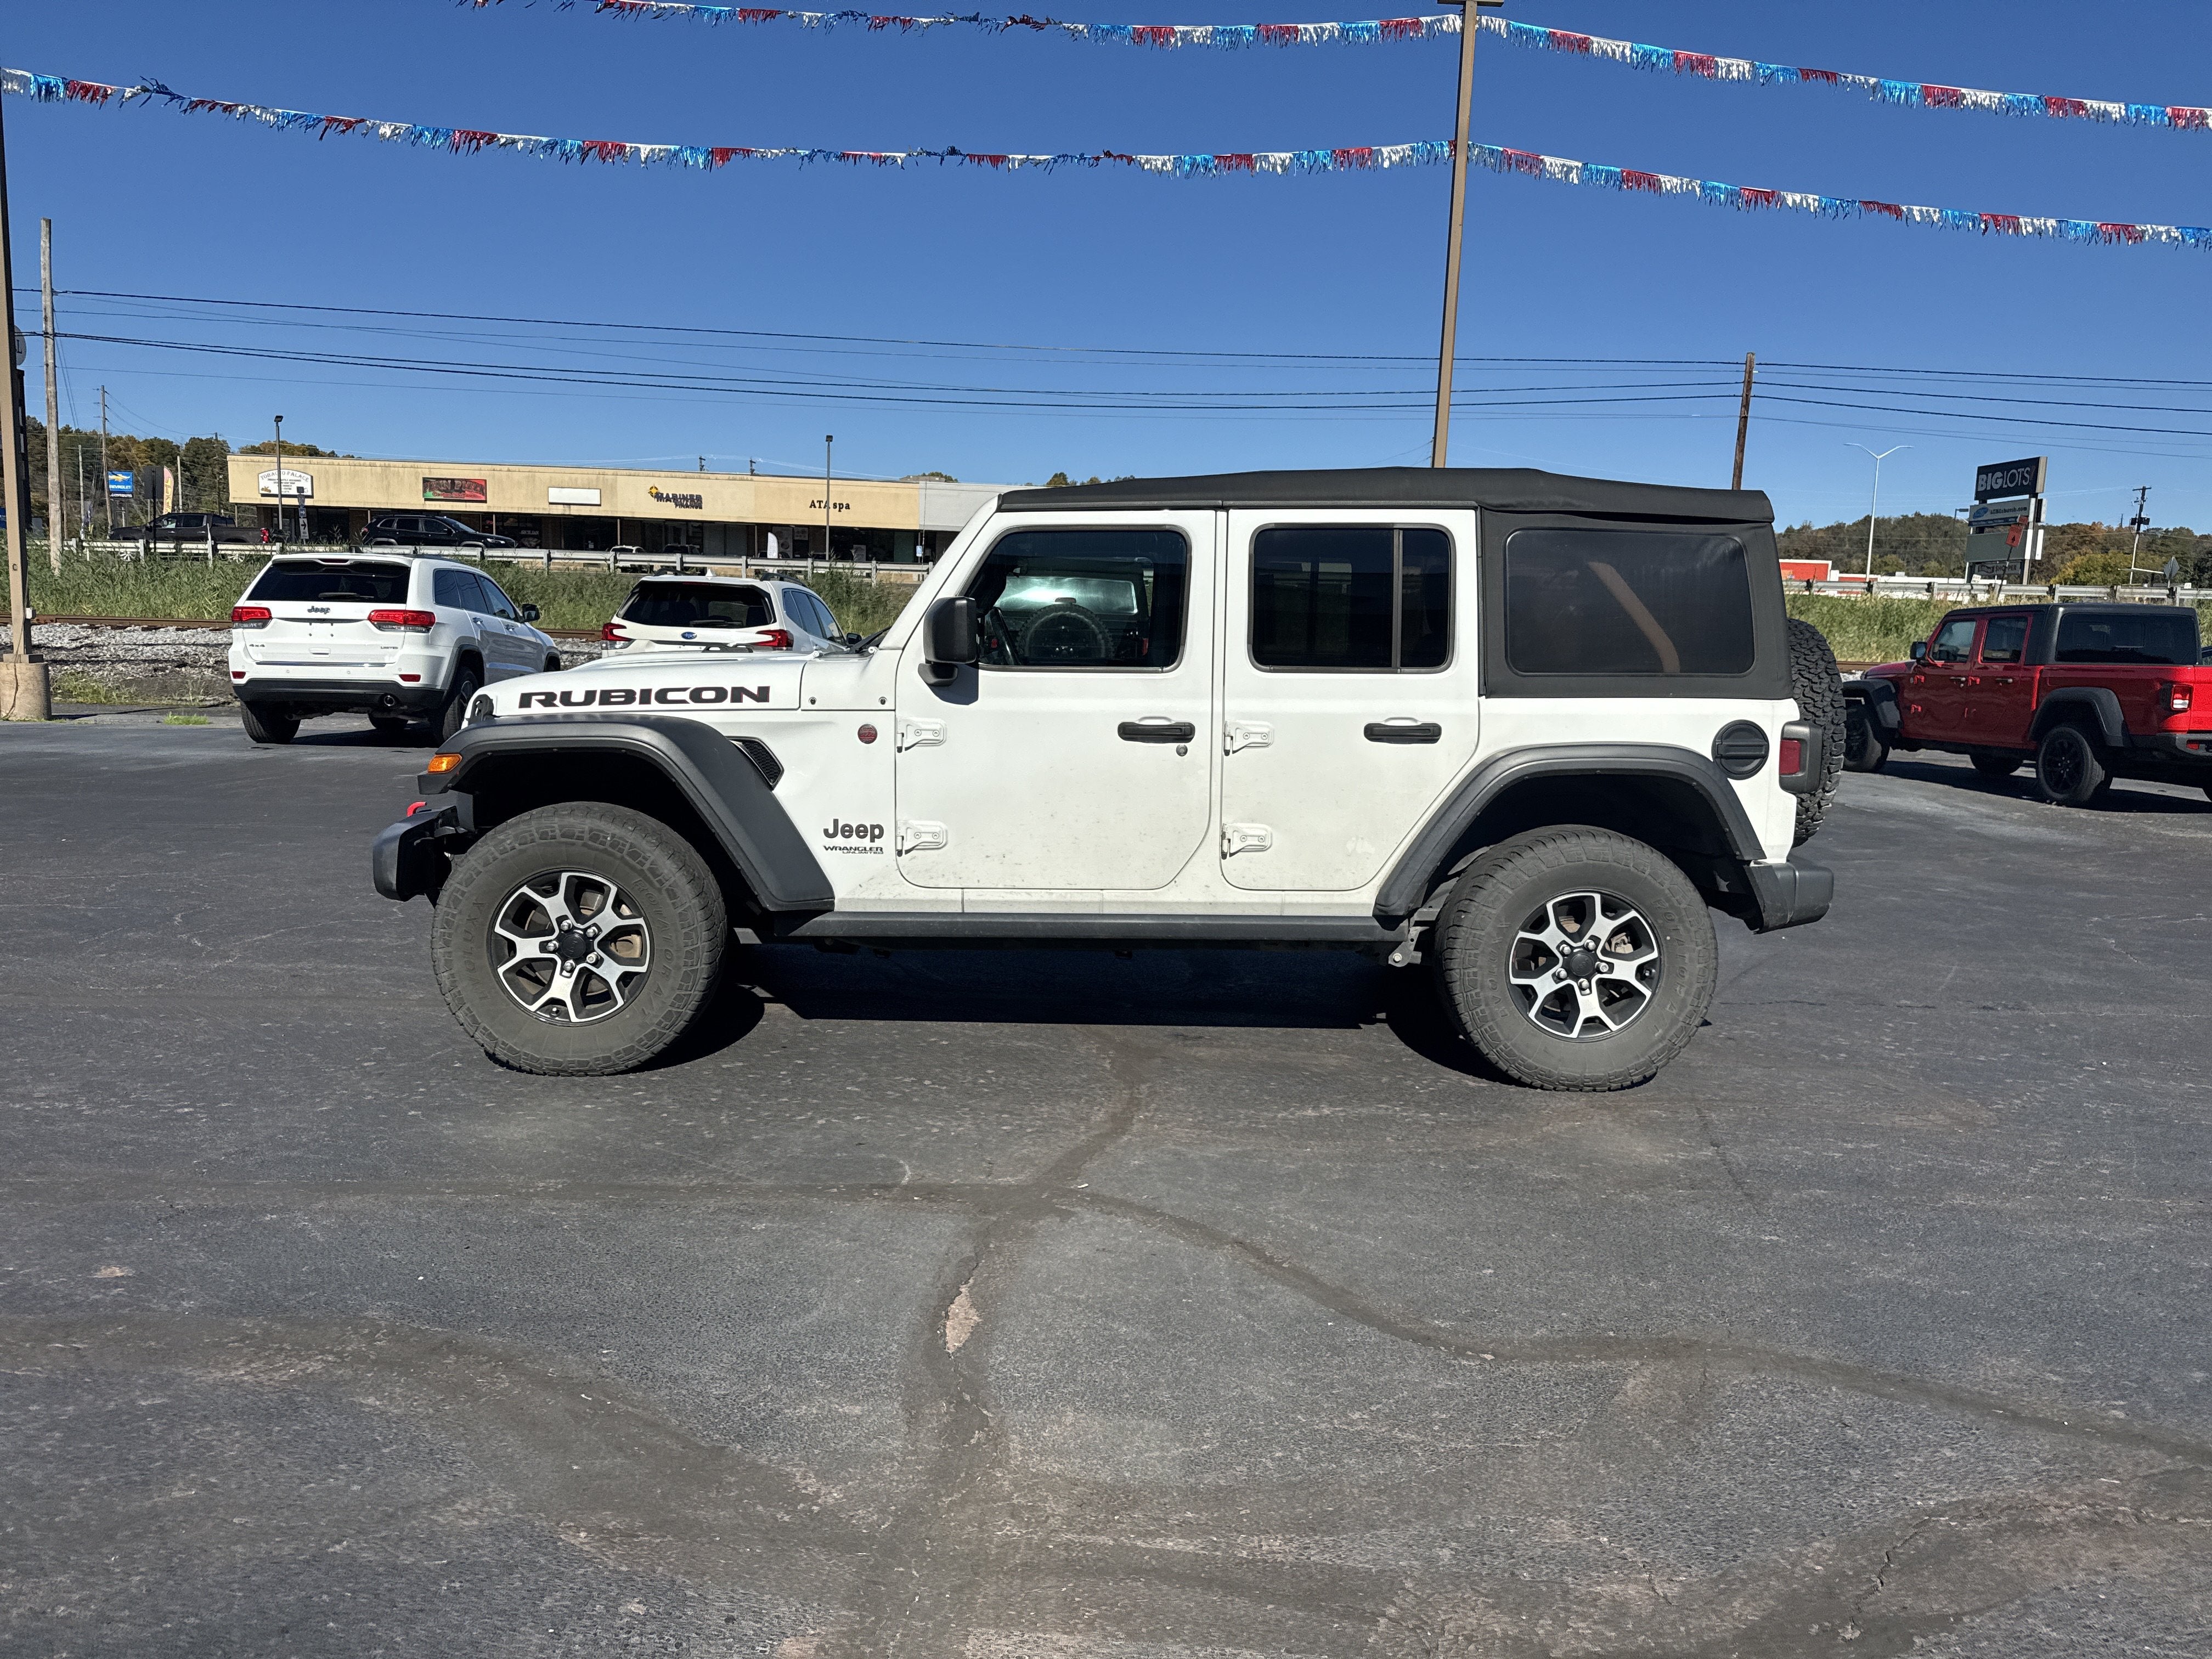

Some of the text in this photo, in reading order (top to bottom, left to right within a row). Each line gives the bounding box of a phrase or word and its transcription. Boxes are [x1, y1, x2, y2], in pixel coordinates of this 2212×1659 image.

[261, 471, 309, 482] TOBACO PALACE
[833, 502, 850, 512] spa
[307, 606, 331, 614] Jeep
[518, 685, 770, 709] RUBICON
[823, 819, 884, 843] Jeep
